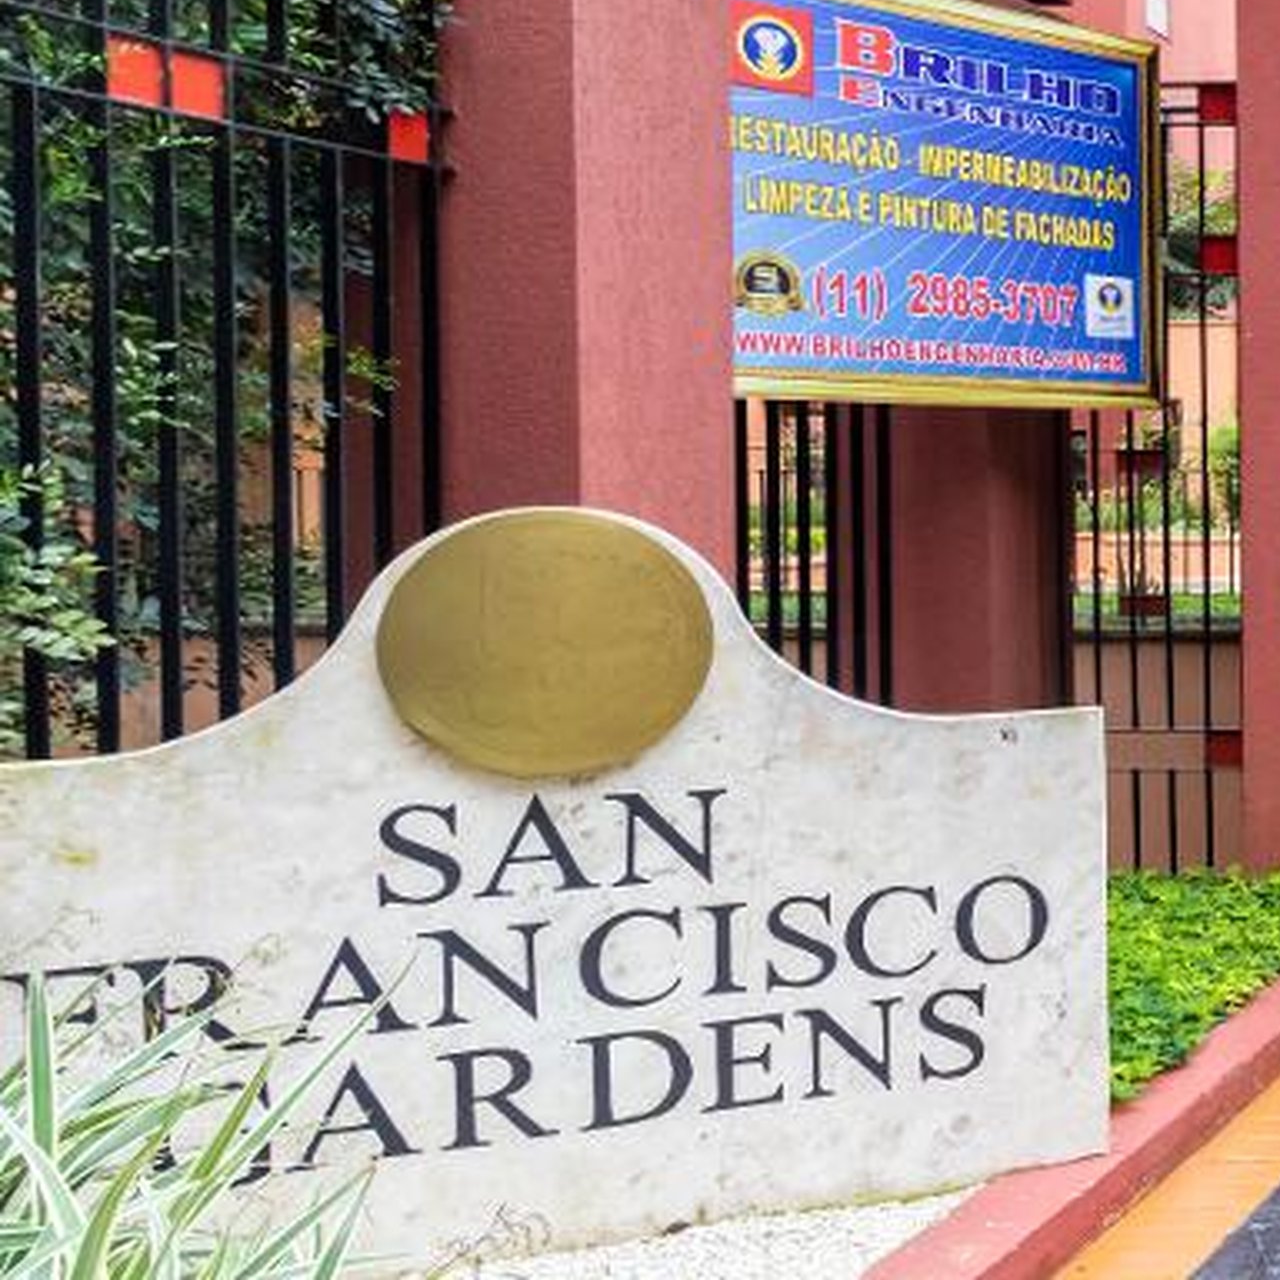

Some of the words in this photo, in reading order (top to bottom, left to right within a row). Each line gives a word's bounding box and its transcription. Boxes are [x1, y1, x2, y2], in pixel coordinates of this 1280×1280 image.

[835, 17, 1121, 117] BRILHO
[745, 173, 851, 221] LIMPEZA
[858, 192, 872, 222] E
[880, 192, 975, 237] PINTURA
[983, 206, 1009, 239] DE
[1015, 211, 1115, 251] FACHADAS
[919, 144, 1131, 209] IMPERMEABILIZAÇÃO
[812, 265, 887, 321] (11)
[908, 271, 1078, 327] 2985-3707
[377, 787, 728, 907] SAN
